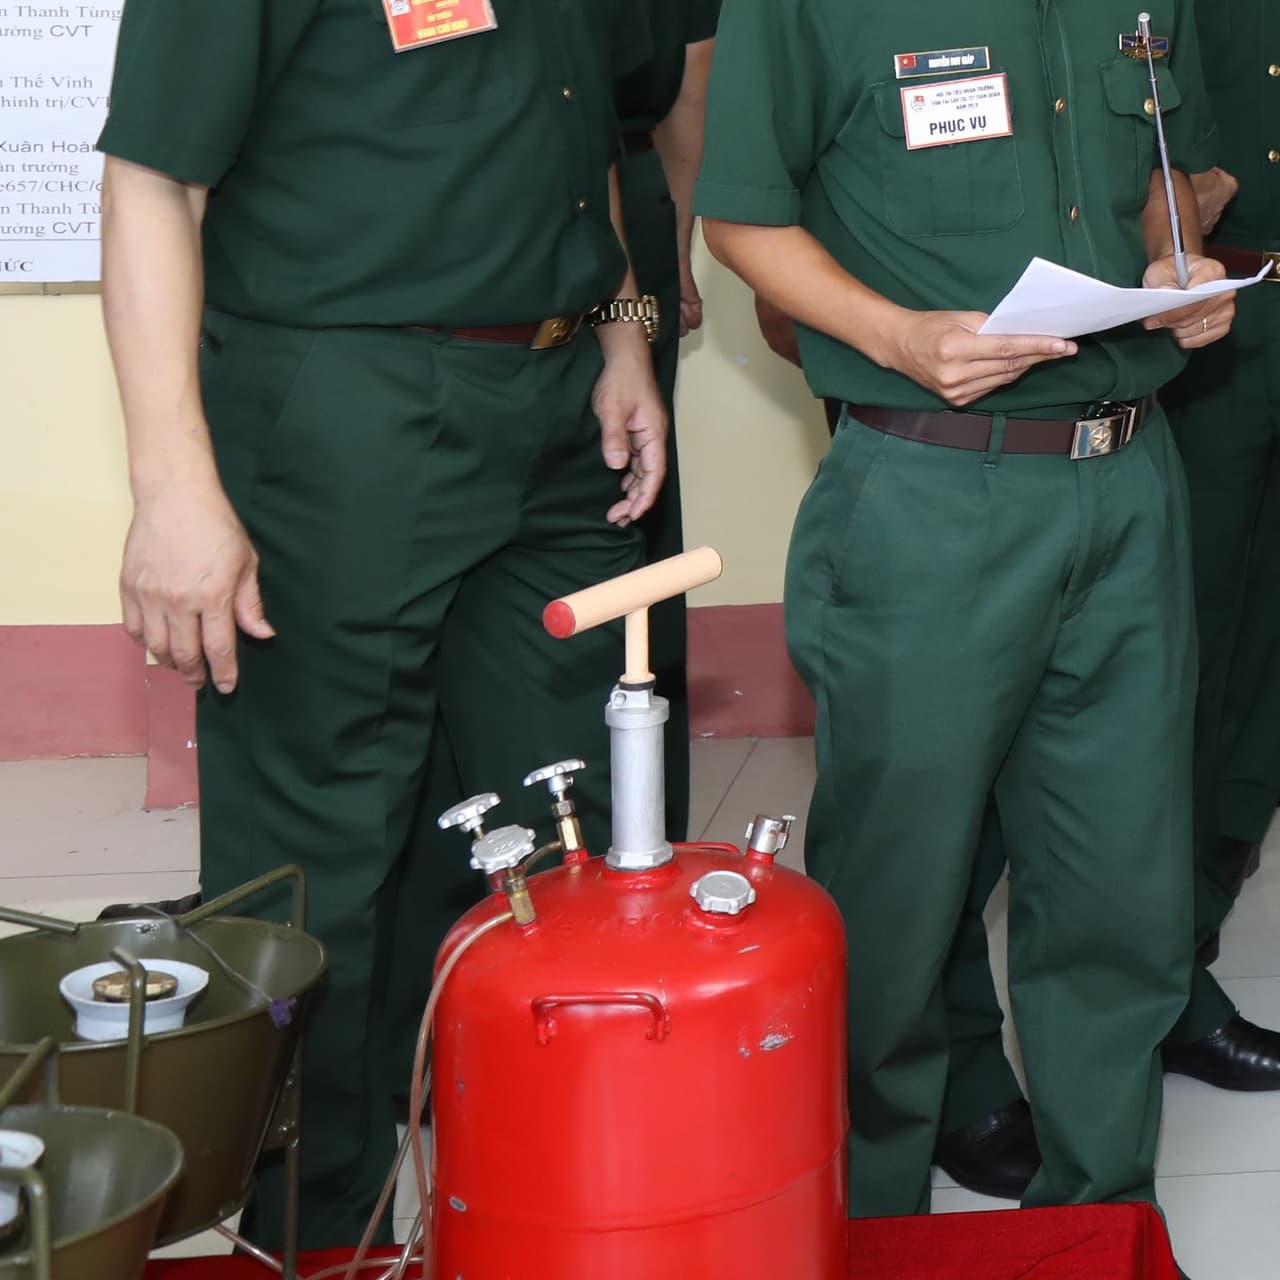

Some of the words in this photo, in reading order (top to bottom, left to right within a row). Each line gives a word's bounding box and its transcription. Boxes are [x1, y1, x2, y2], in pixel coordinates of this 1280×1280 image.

[14, 6, 69, 18] Thanh
[76, 6, 121, 22] Tùng
[50, 25, 93, 38] CVT
[10, 73, 44, 88] Thế
[929, 118, 965, 136] PHỤC
[969, 115, 987, 132] VỤ
[16, 203, 72, 215] Thanh
[52, 222, 96, 234] CVT
